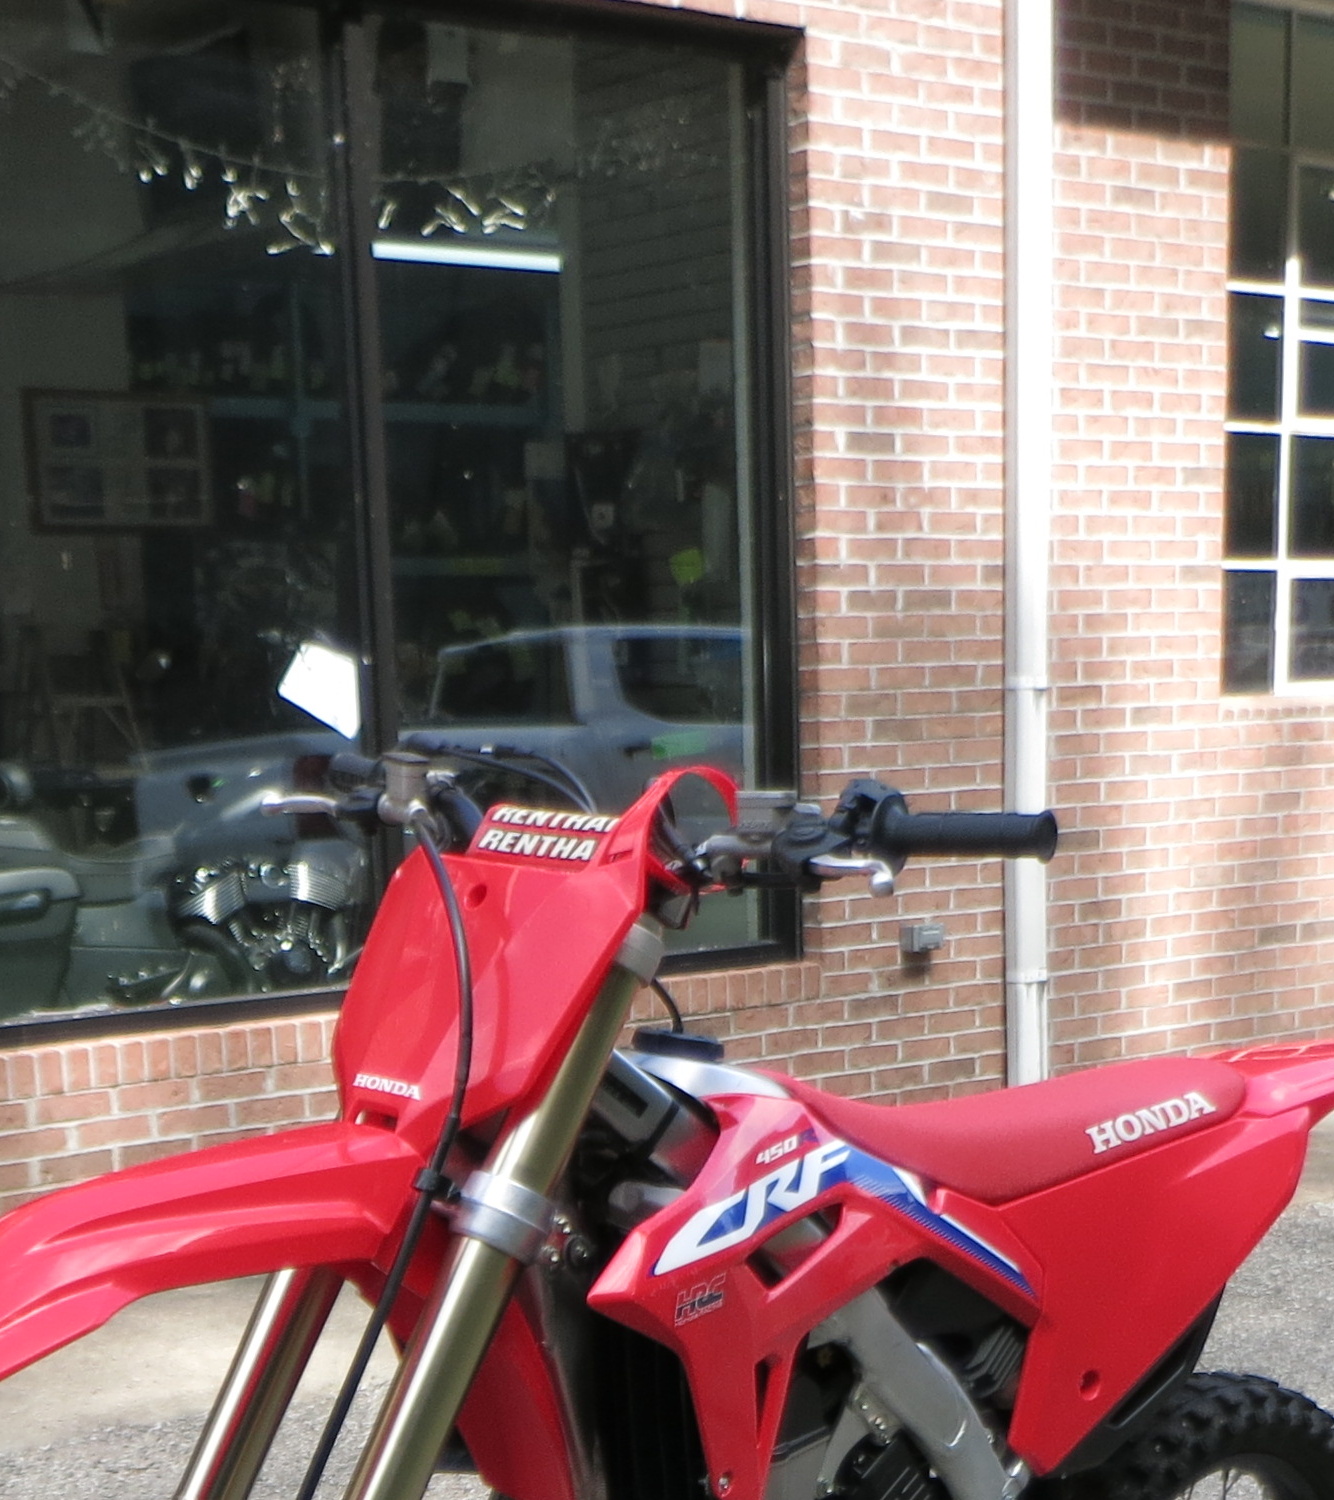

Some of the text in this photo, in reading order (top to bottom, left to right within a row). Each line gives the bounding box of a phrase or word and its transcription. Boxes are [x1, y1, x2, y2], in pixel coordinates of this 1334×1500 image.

[352, 1073, 421, 1100] HONDA
[1085, 1091, 1216, 1154] HONDA
[653, 1138, 852, 1277] CRF
[674, 1272, 727, 1322] HRC
